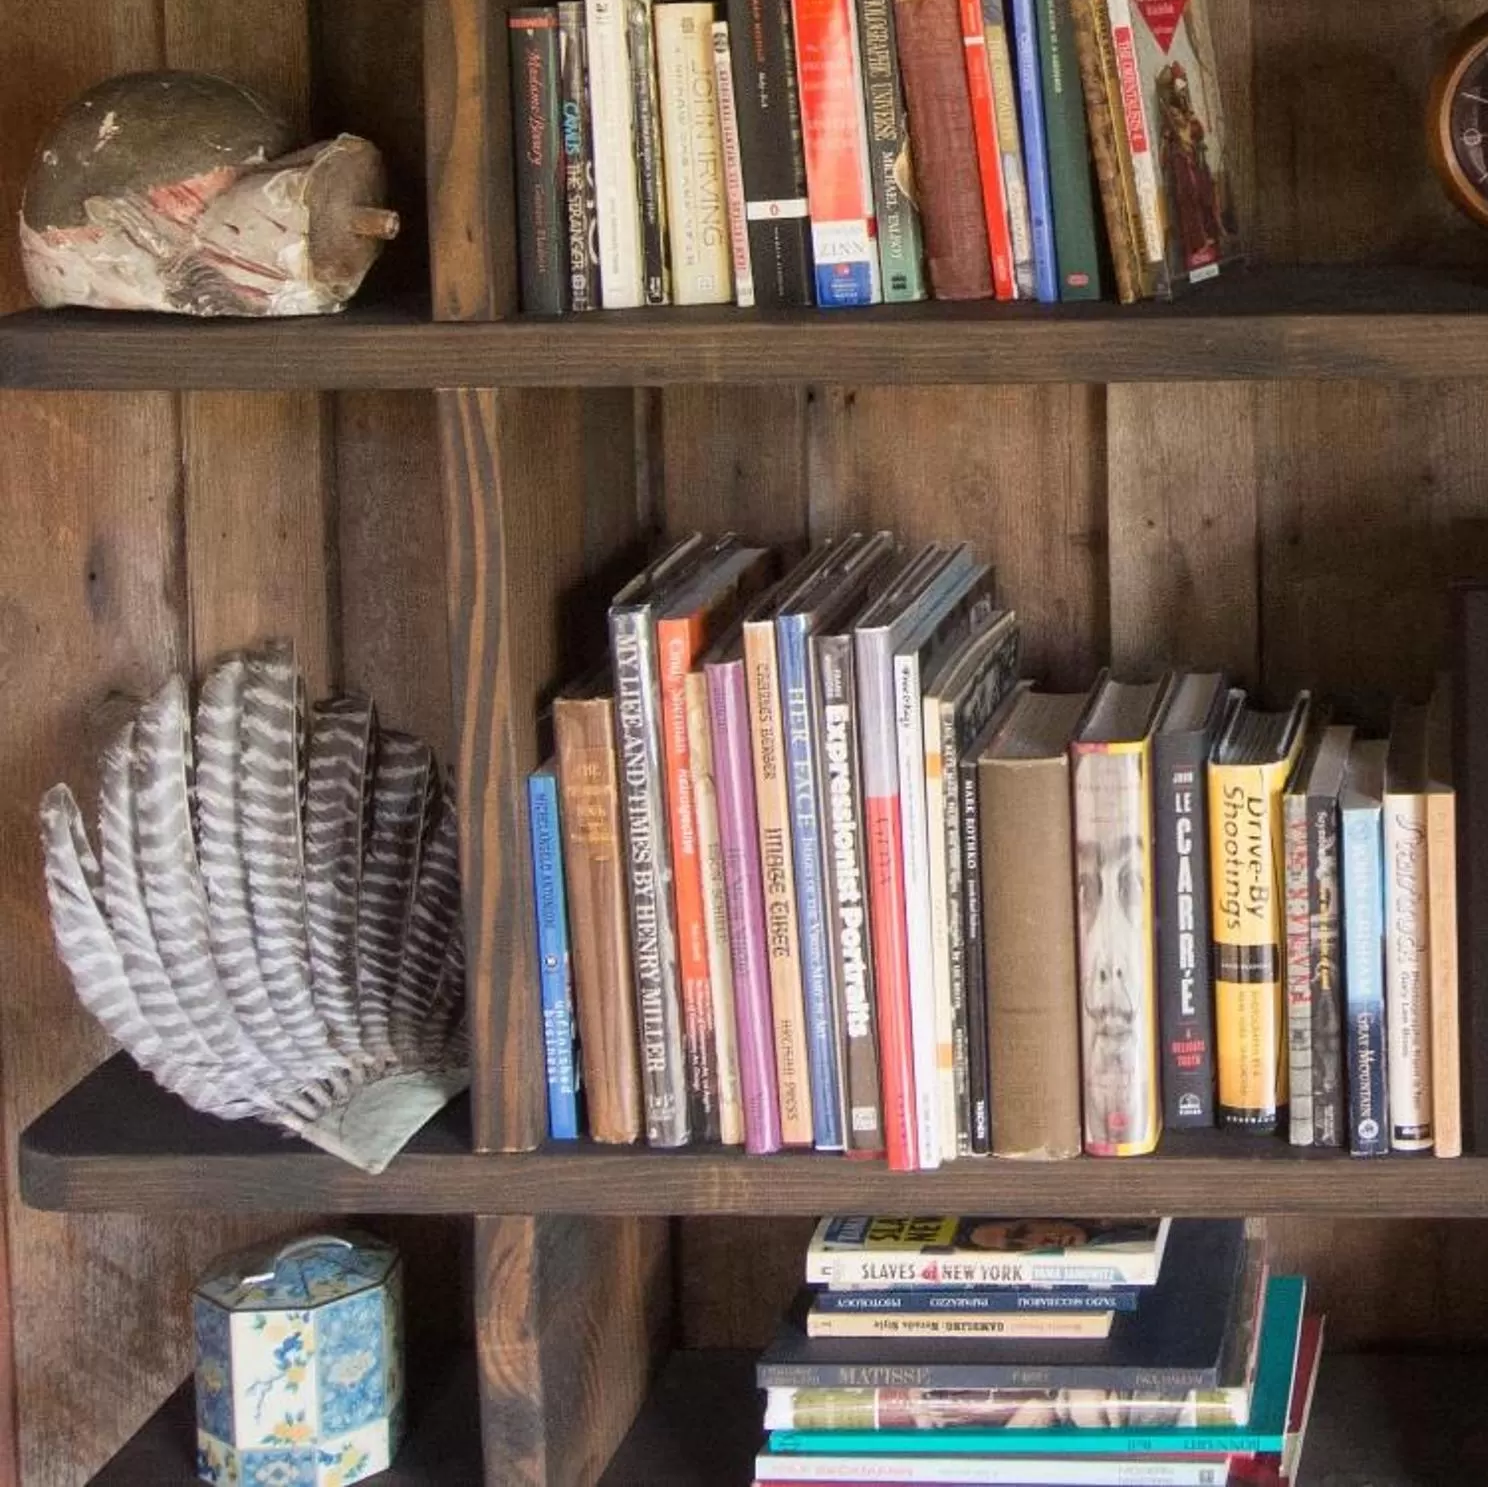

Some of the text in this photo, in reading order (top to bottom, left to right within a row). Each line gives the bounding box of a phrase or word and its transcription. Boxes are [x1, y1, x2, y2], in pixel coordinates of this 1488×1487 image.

[524, 48, 547, 167] Madame Bovary
[561, 100, 582, 156] CAMUS
[867, 80, 898, 142] UNIVERSE
[689, 59, 725, 248] JOHN IRVING
[879, 150, 899, 210] MICHAEL
[565, 162, 589, 271] THE STRANGER
[668, 638, 696, 856] Cindy Sherman Retrospective
[756, 662, 777, 780] CHARLES BERGER
[788, 687, 815, 829] HER FACE
[1172, 772, 1194, 784] JOHN
[1175, 792, 1193, 814] LE
[617, 632, 667, 1074] MY LIFE AND TIMES BY HENRY MILLER
[964, 780, 977, 869] MARK ROTHKO
[1219, 783, 1244, 931] Shootings
[1246, 796, 1270, 918] Drive-By
[764, 827, 791, 958] IMAGE TIBET
[825, 703, 870, 1038] Expressionist Portraits
[810, 965, 824, 998] MARY
[544, 1009, 559, 1084] business
[554, 1000, 572, 1094] unfinished
[813, 1016, 827, 1040] ART
[1355, 1012, 1376, 1118] GRAY MOUNTAIN
[975, 1098, 985, 1139] TASCHEN
[836, 1296, 902, 1309] PHOTOLOGY
[861, 1262, 1023, 1283] SLAVES of NEW YORK
[839, 1367, 933, 1385] MATISSE
